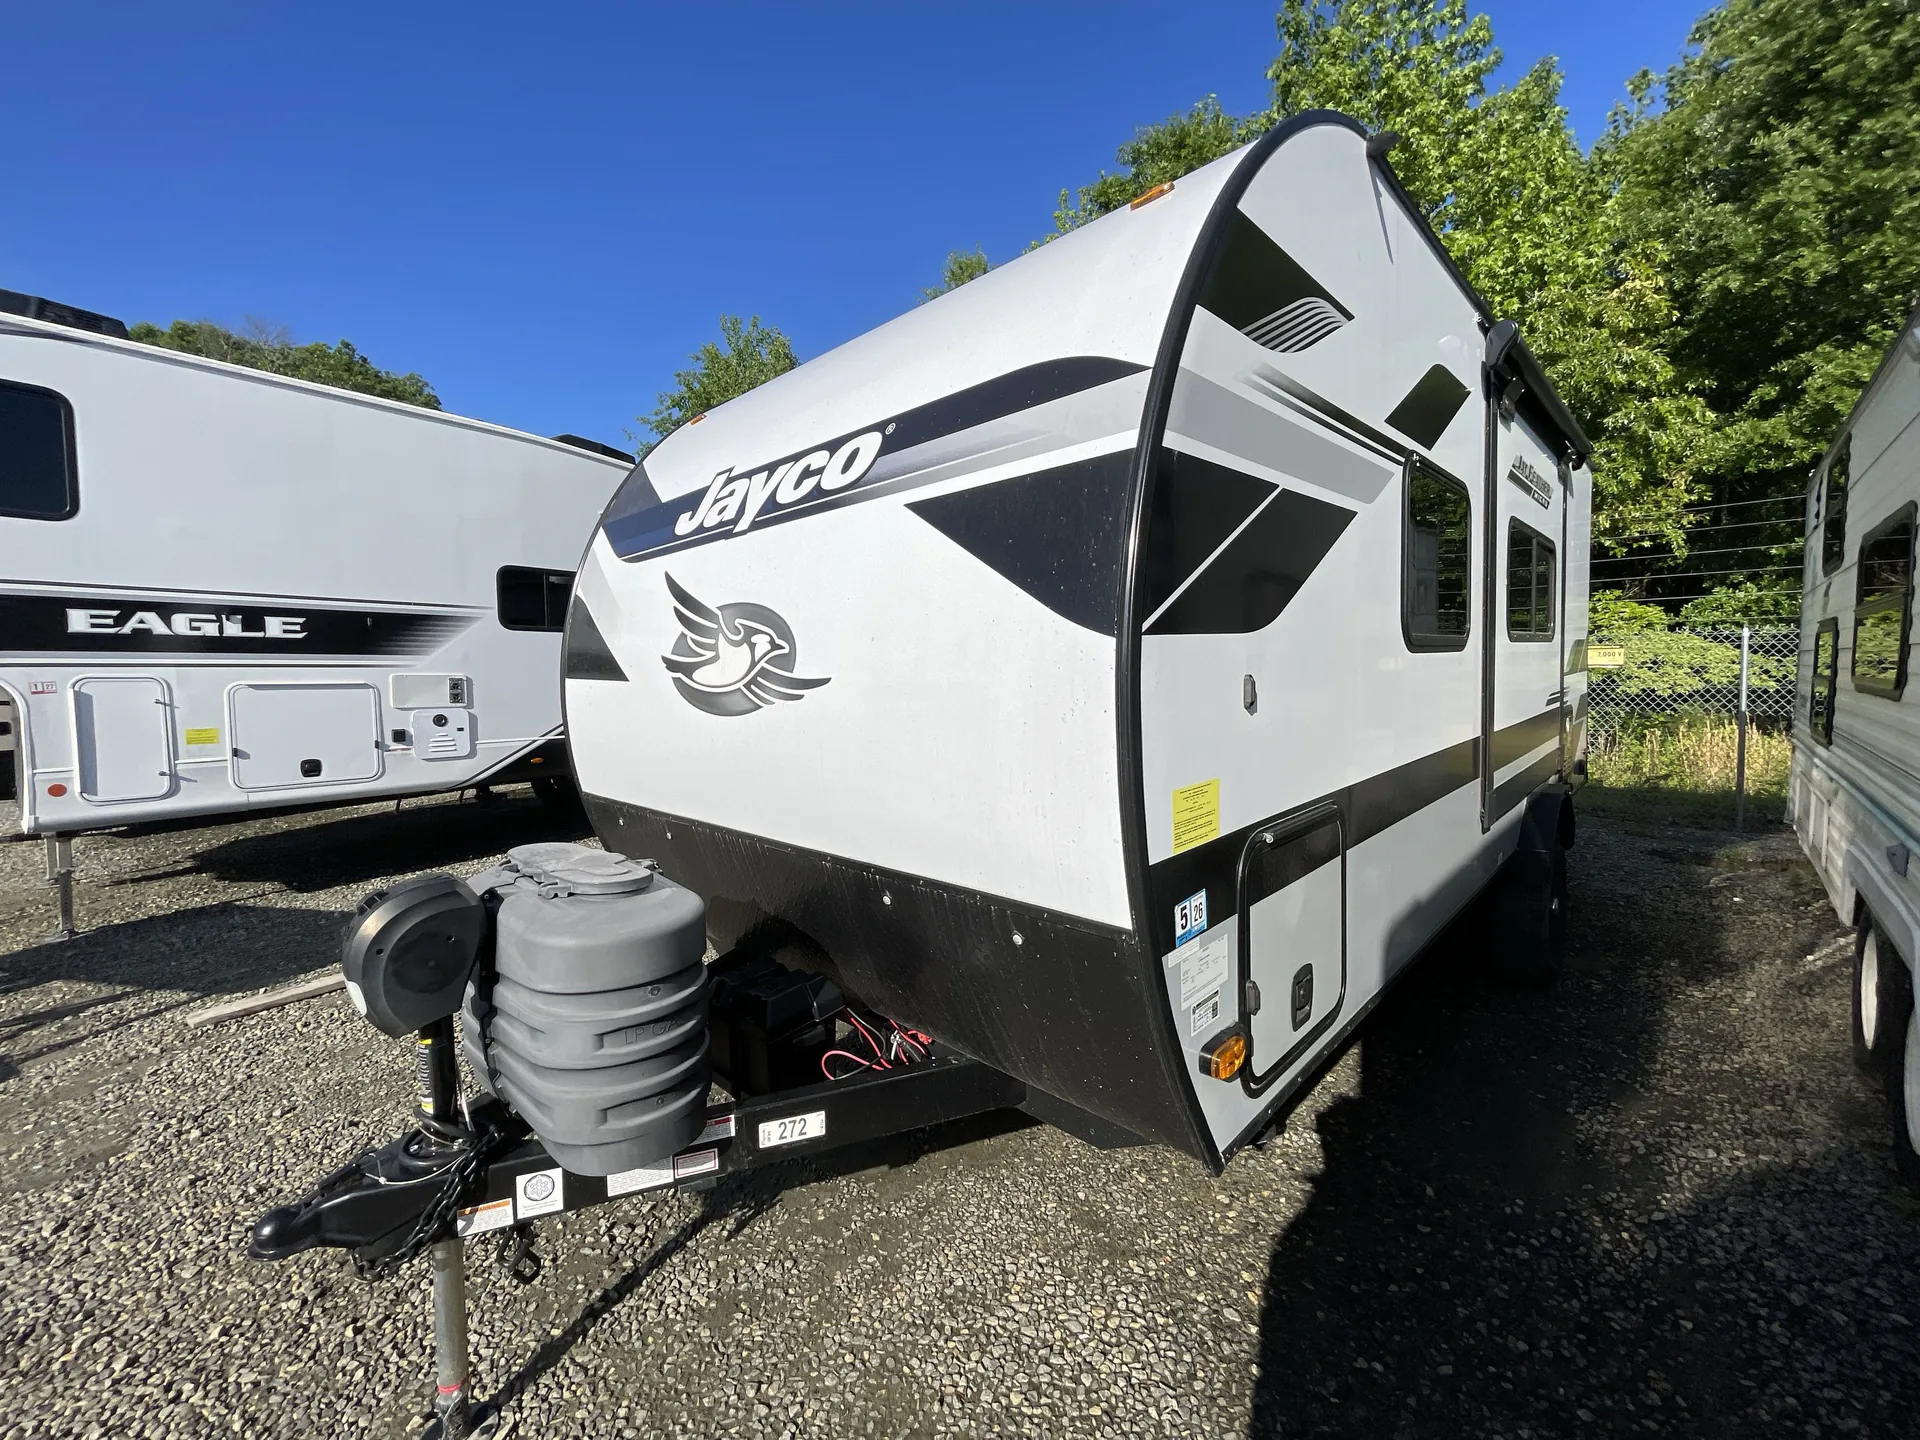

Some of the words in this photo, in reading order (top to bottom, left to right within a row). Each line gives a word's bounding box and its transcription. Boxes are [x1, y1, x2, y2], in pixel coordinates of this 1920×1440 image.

[674, 431, 883, 536] Jayco
[65, 608, 308, 638] EAGLE
[1180, 905, 1188, 930] 5
[1193, 901, 1204, 922] 26
[624, 1026, 645, 1044] LP
[778, 1117, 808, 1141] 272
